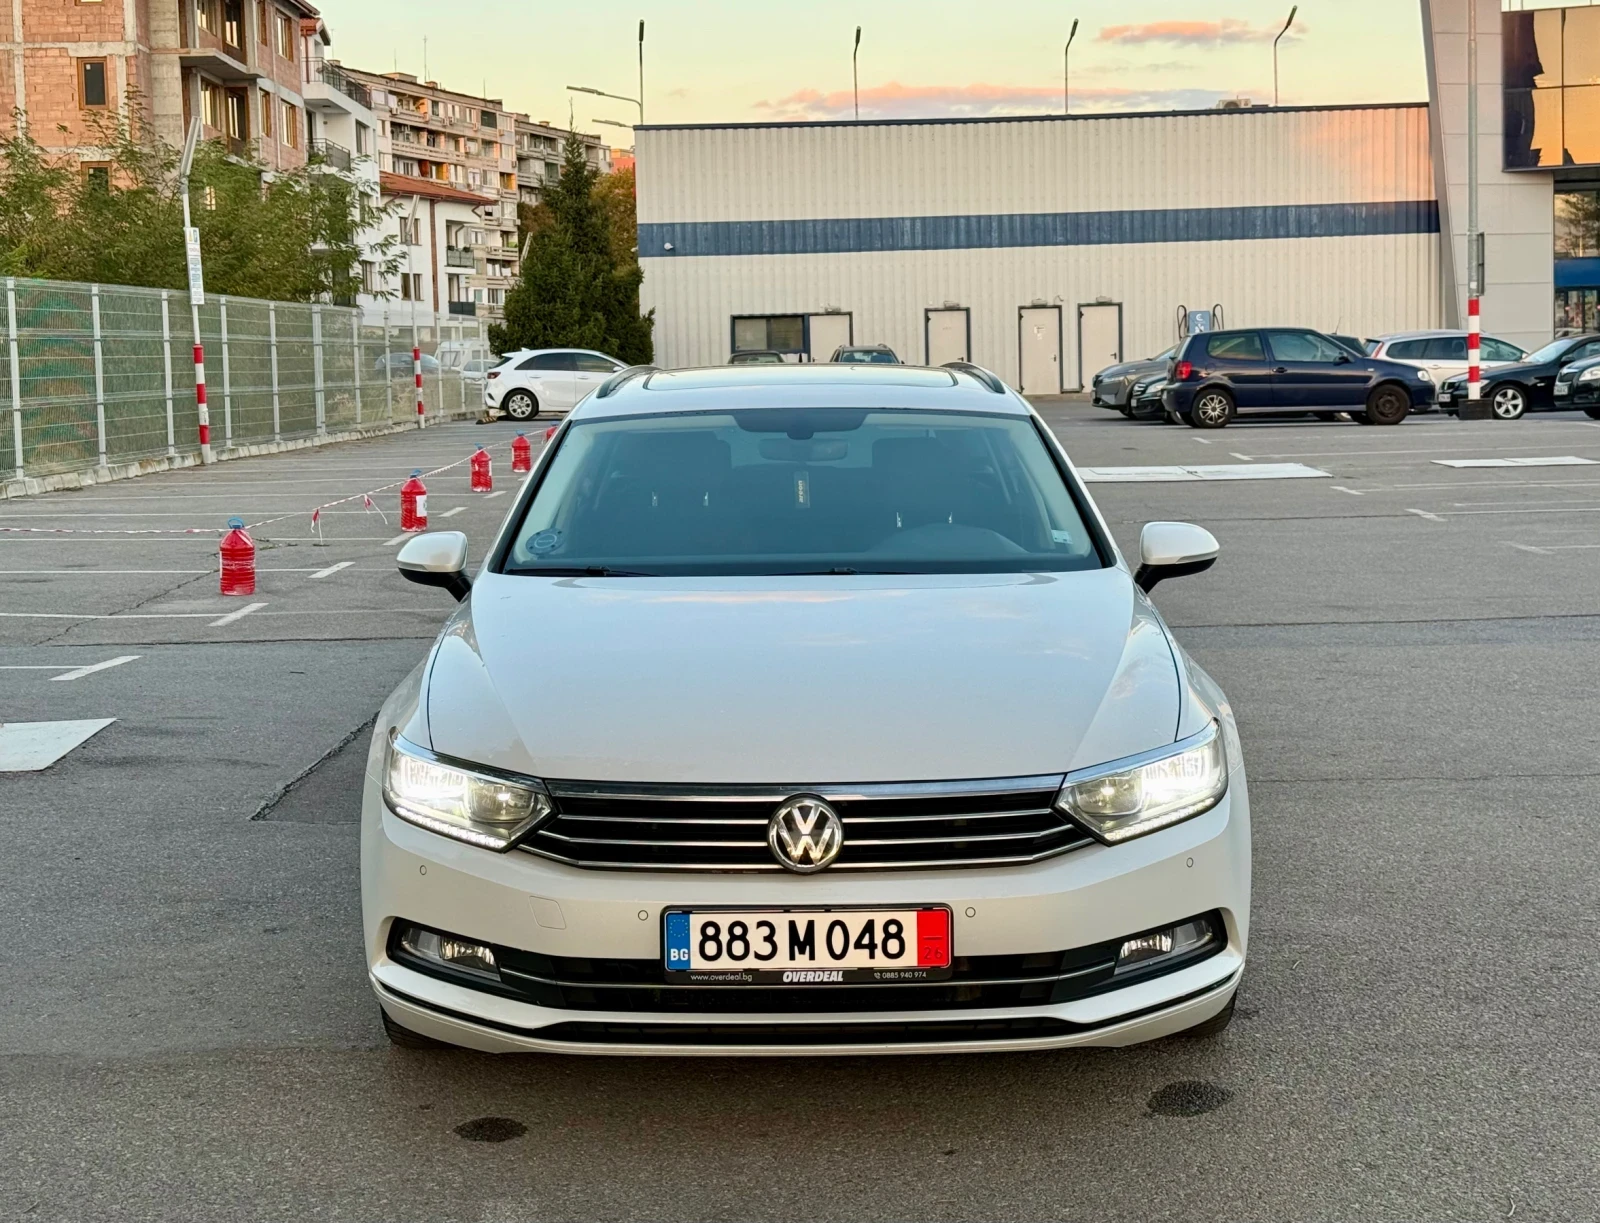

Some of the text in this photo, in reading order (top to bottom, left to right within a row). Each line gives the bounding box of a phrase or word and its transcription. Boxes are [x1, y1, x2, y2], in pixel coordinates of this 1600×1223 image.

[699, 918, 906, 962] 883 M 048
[670, 948, 689, 961] BG
[923, 946, 943, 960] 26
[690, 973, 753, 982] www.overdeal.bg
[782, 970, 844, 983] OVERDEAL
